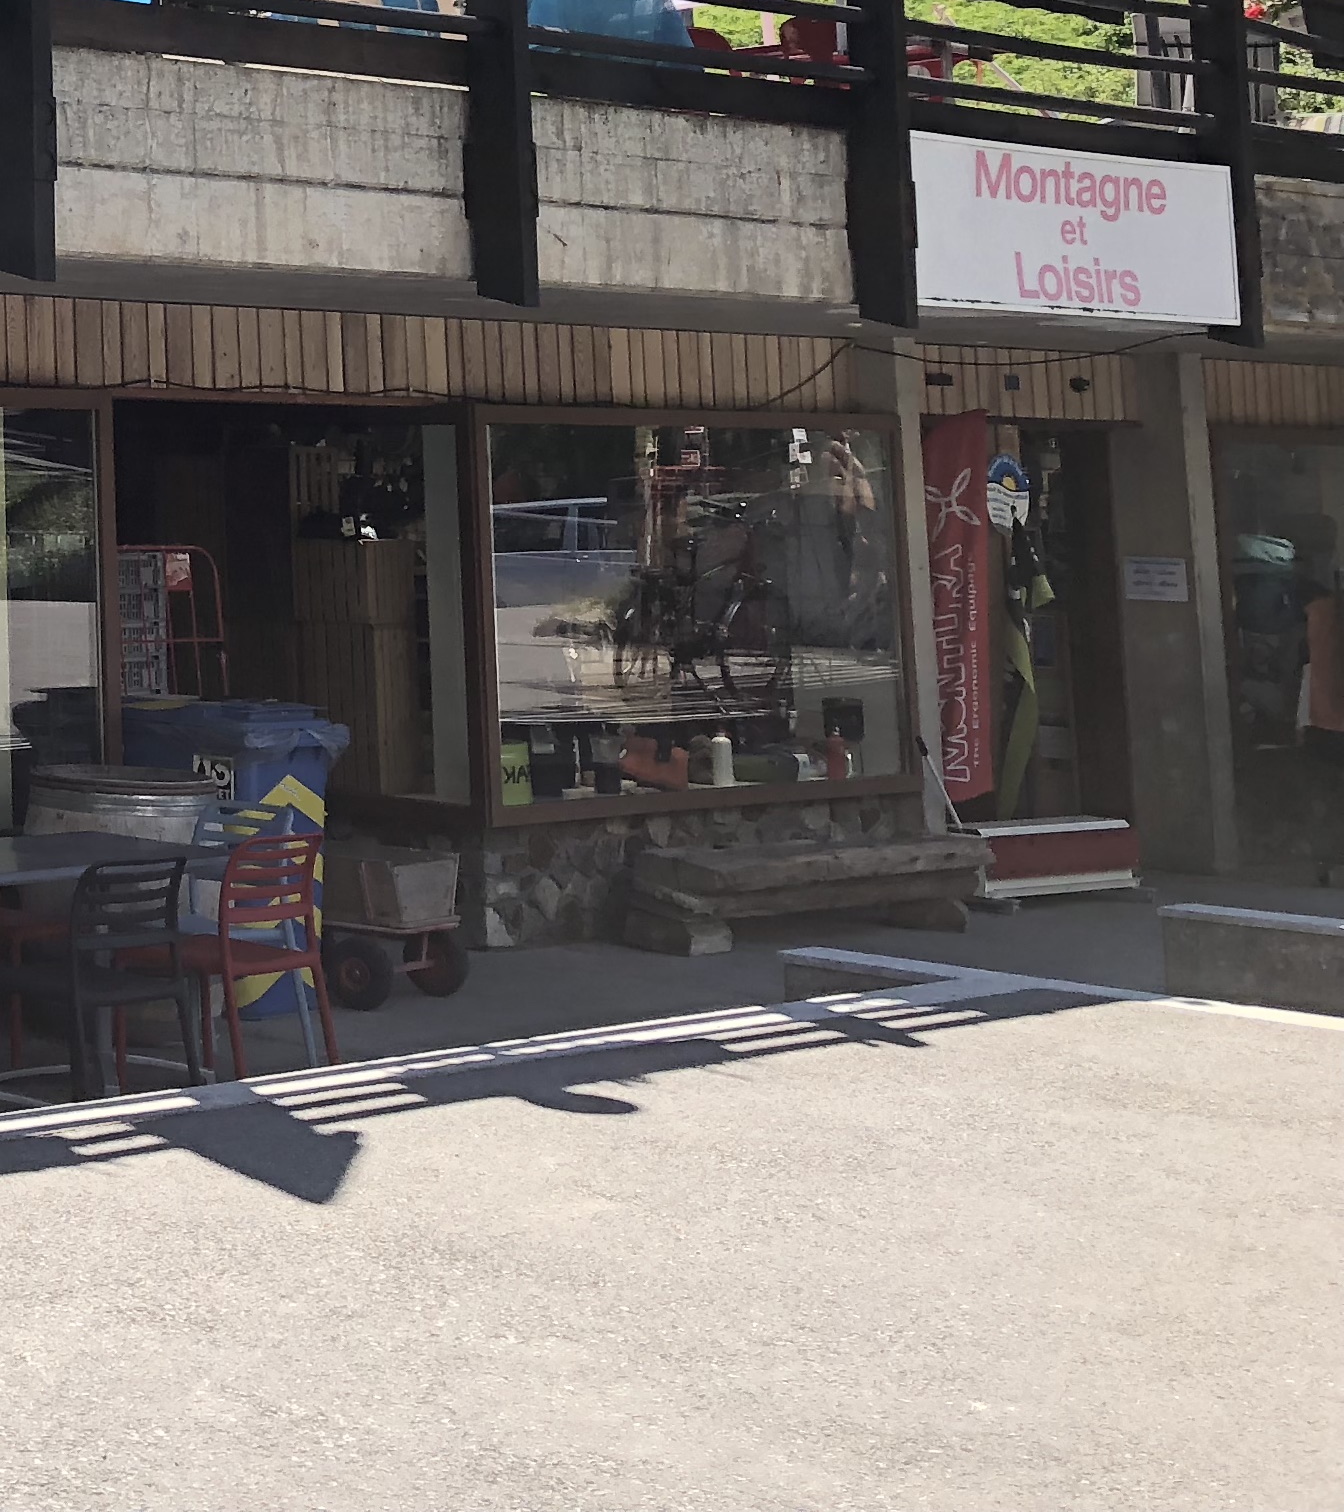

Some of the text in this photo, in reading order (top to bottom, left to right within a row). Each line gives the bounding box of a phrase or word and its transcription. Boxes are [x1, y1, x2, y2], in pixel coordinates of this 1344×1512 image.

[974, 149, 1168, 222] Montagne
[1060, 215, 1089, 246] et
[1014, 250, 1142, 308] Loisirs
[932, 542, 971, 785] MONTURA
